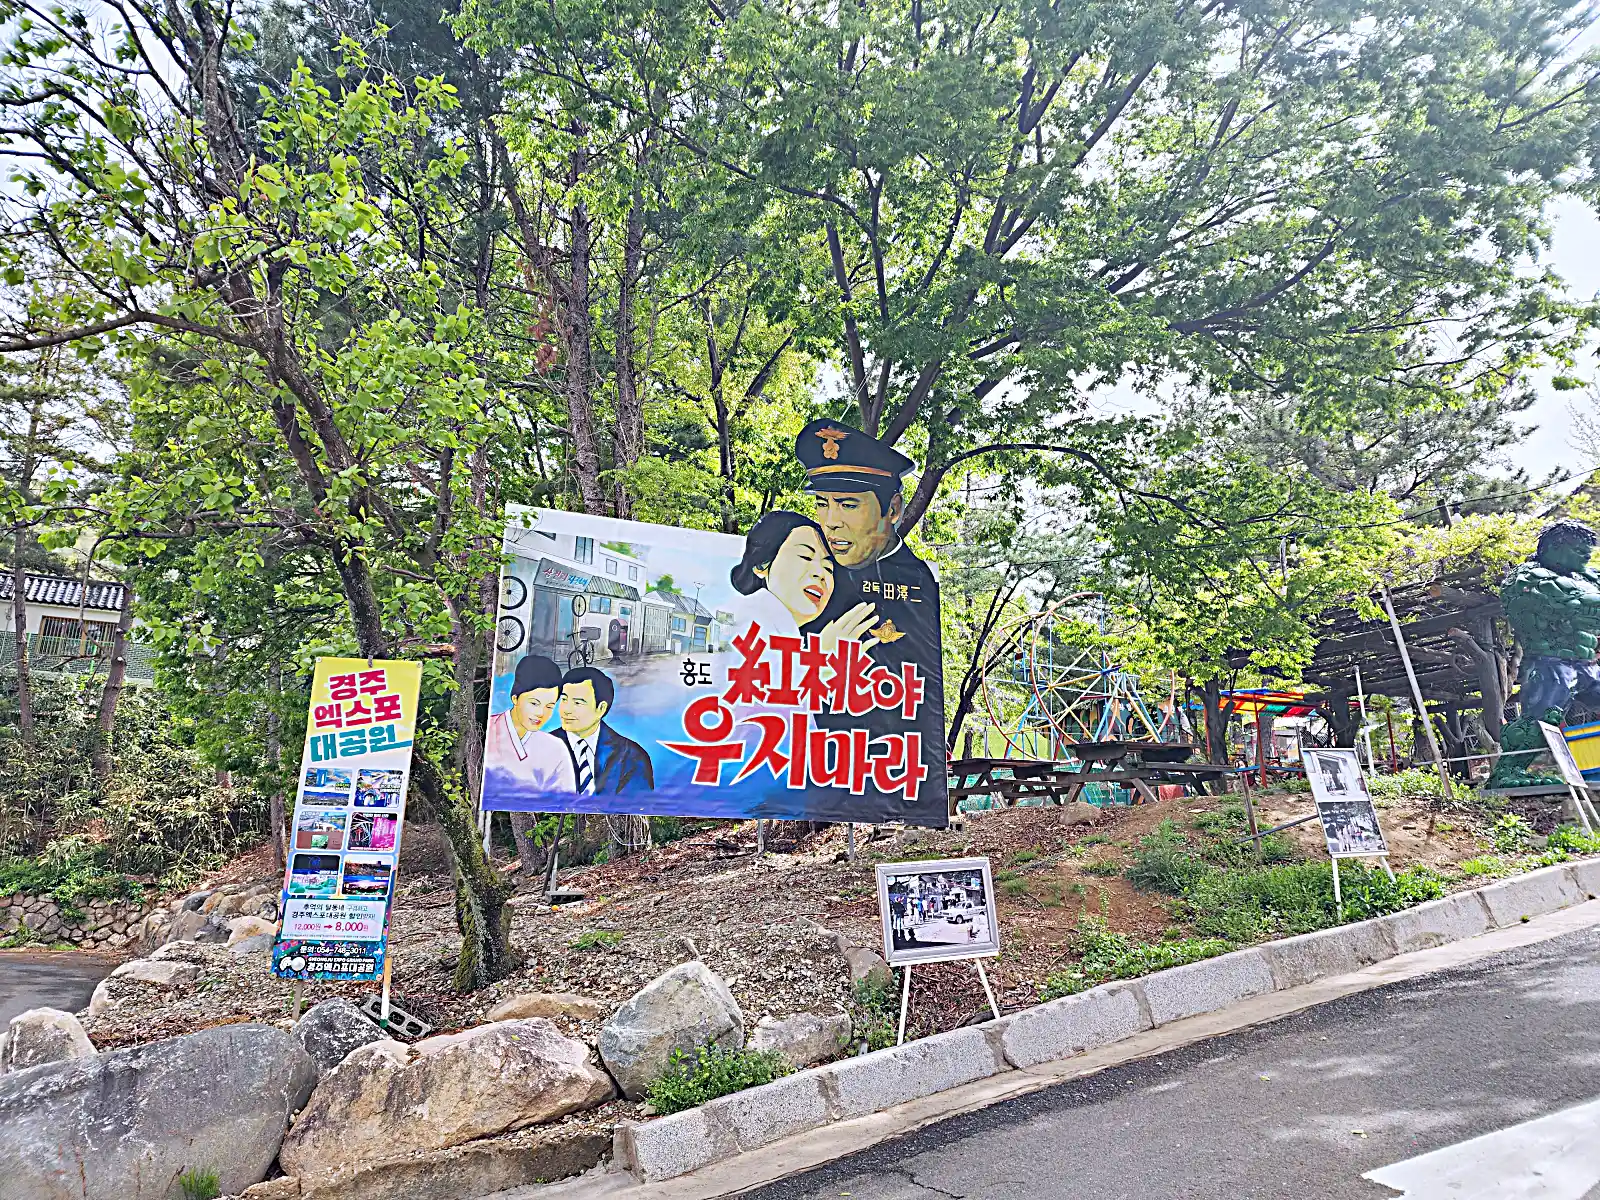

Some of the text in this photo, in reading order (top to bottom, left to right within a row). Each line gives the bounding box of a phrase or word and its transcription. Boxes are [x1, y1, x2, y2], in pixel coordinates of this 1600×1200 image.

[862, 580, 880, 594] 감독
[328, 668, 388, 701] 경주
[680, 620, 926, 721] 홍도 紅桃야
[313, 693, 403, 729] 엑스포
[309, 723, 414, 763] 대공원
[656, 695, 929, 801] 우지마라
[291, 911, 346, 919] 경주엑스포대공원
[306, 962, 375, 973] 경주엑스포대공원
